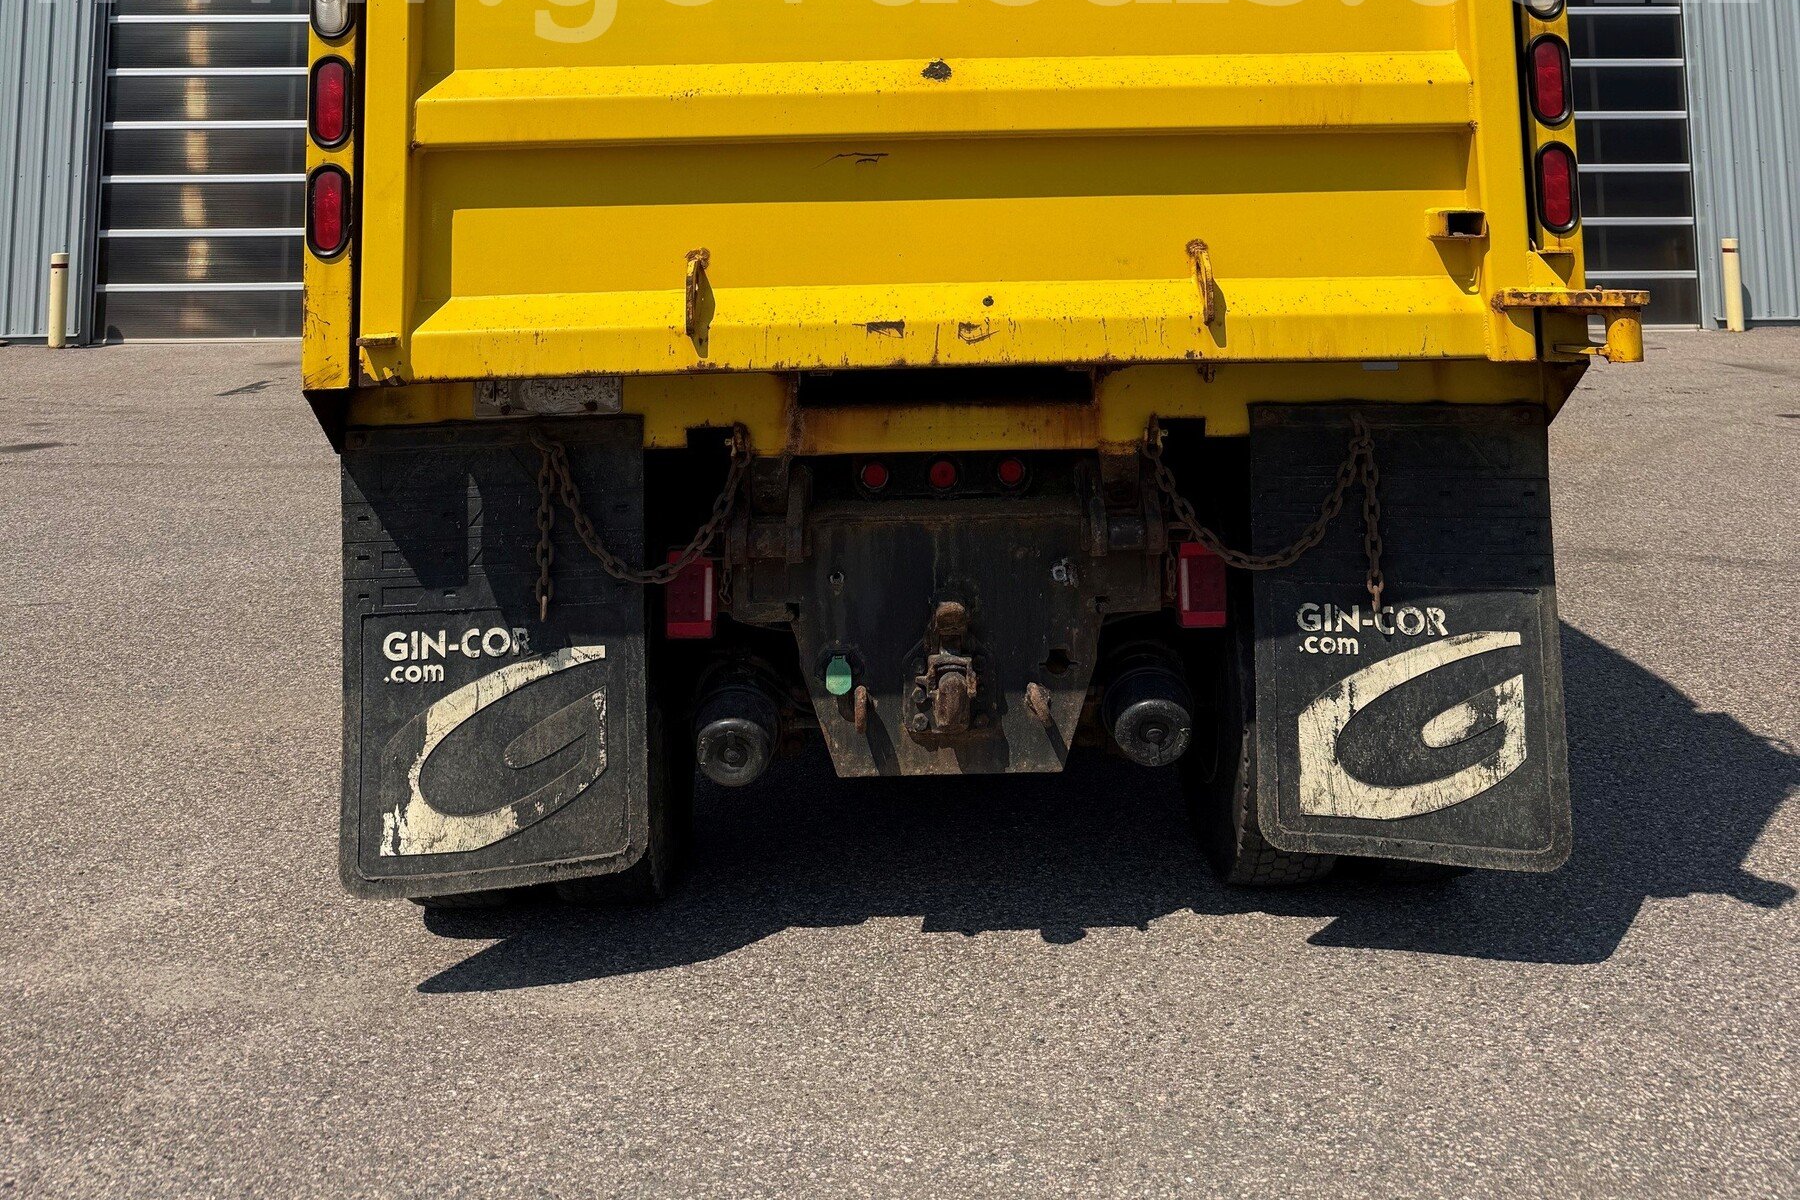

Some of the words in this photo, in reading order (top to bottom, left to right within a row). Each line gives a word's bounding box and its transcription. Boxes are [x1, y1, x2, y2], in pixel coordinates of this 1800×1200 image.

[1296, 602, 1449, 636] GIN-COR
[383, 627, 534, 662] GIN-COR
[1298, 636, 1359, 655] .com
[383, 664, 445, 683] .com
